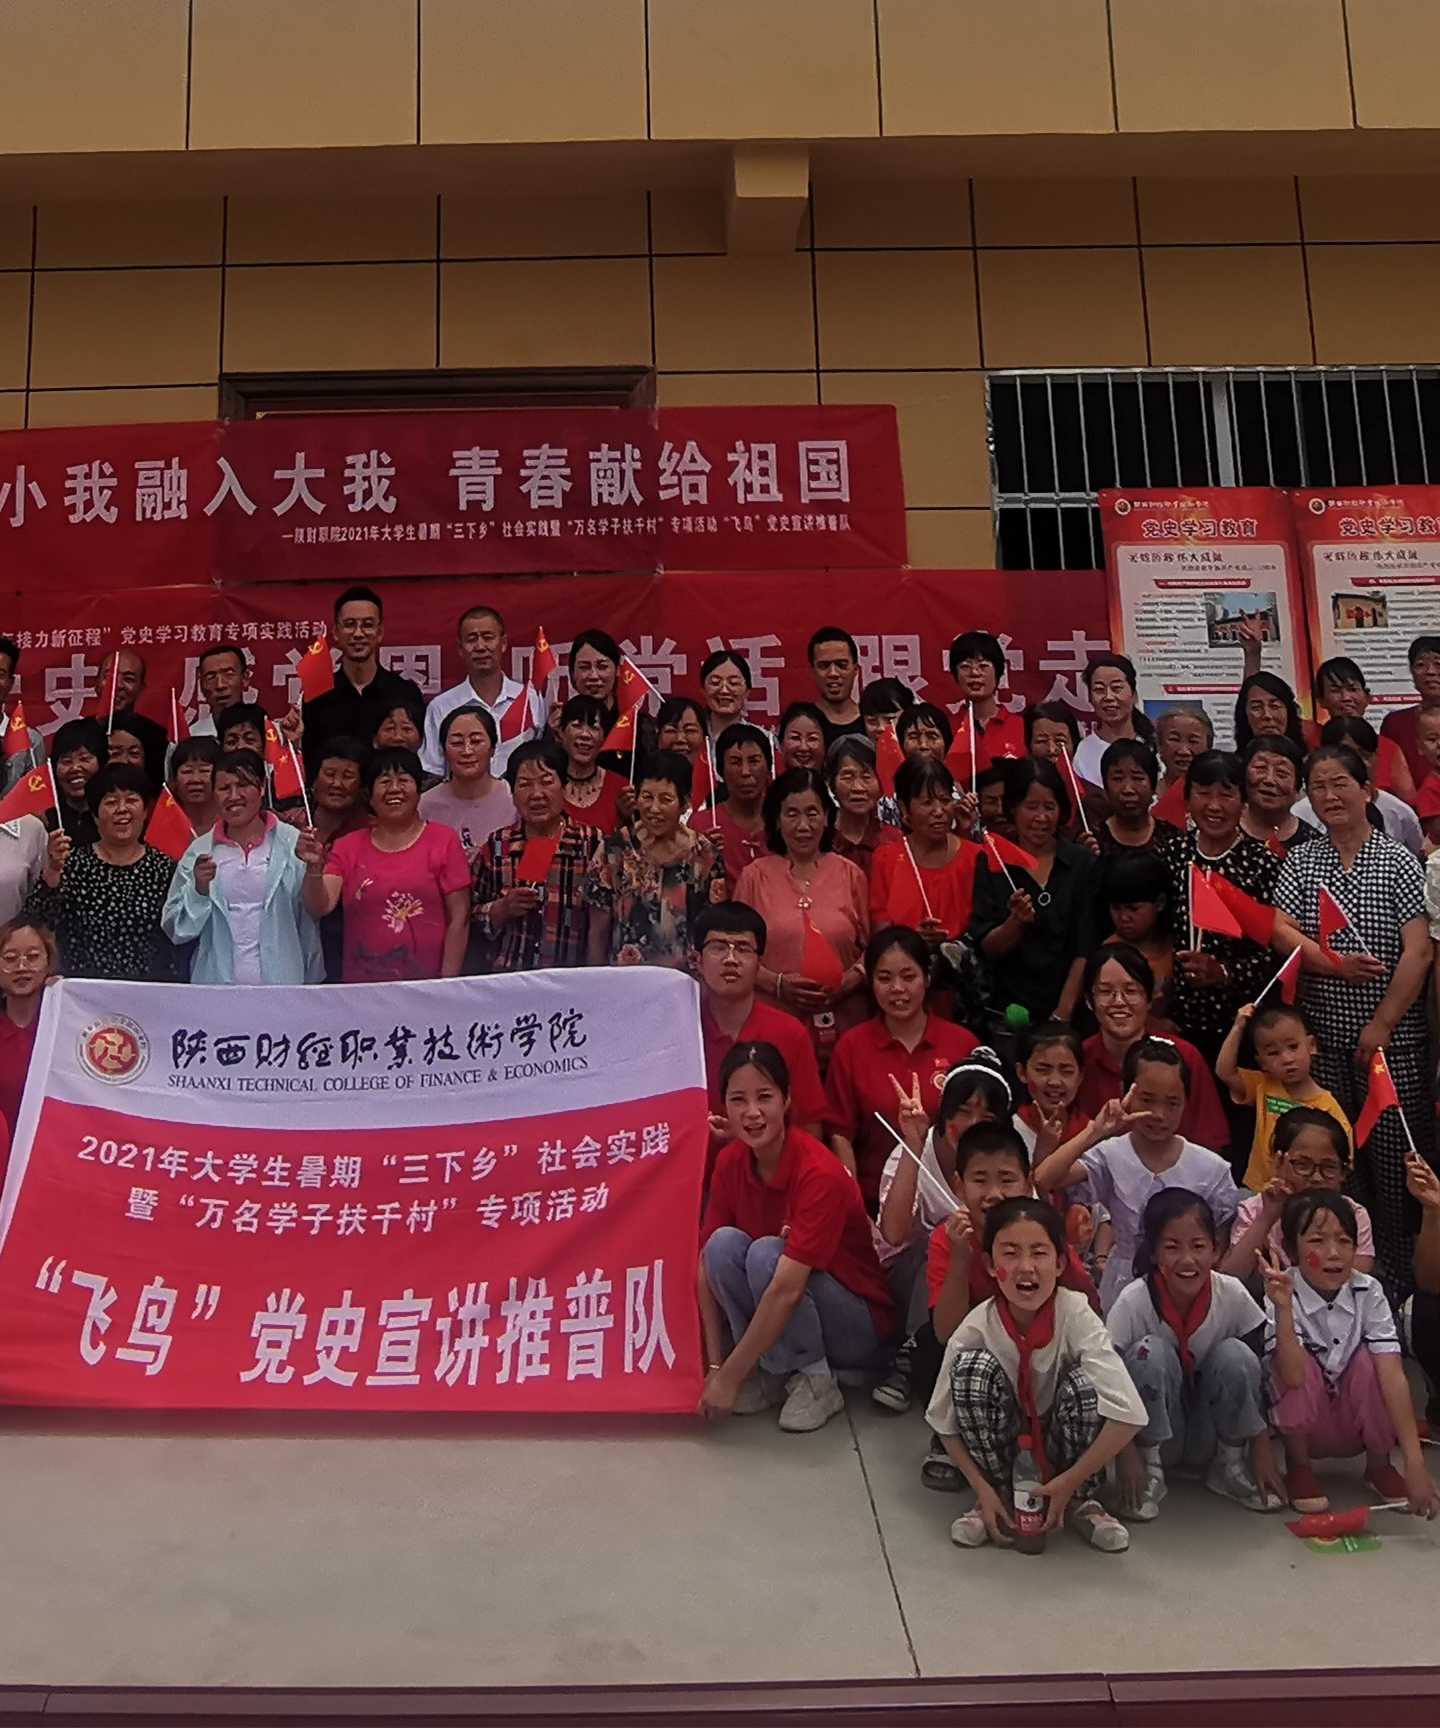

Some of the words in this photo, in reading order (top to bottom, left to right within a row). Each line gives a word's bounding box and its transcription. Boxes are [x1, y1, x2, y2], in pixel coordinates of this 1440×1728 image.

[448, 439, 853, 513] 青春献给祖国
[1141, 518, 1258, 538] 党史学习教育
[167, 1074, 232, 1091] SHAANXI
[237, 1077, 318, 1093] TECHNICAL
[323, 1075, 390, 1091] COLLEGE
[395, 1074, 415, 1088] OF
[420, 1070, 483, 1089] FINANCE
[487, 1069, 498, 1082] &
[504, 1057, 589, 1081] ECONOMICS
